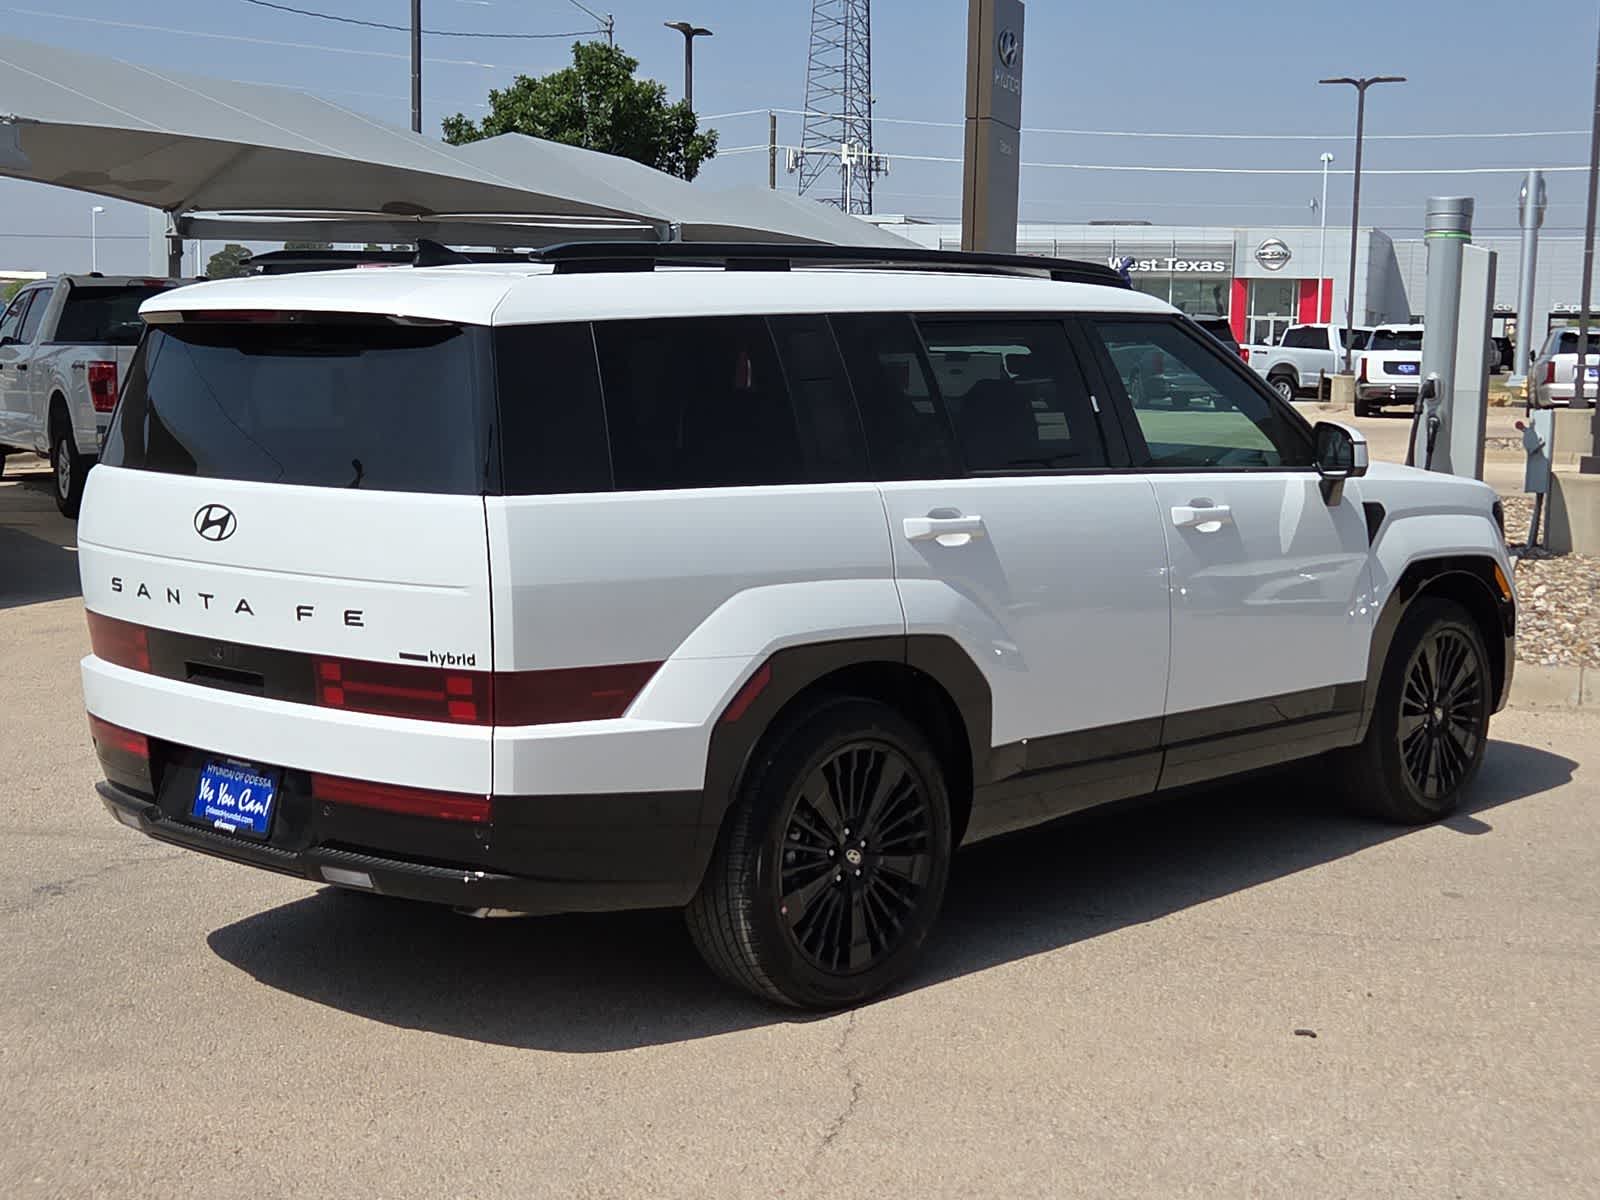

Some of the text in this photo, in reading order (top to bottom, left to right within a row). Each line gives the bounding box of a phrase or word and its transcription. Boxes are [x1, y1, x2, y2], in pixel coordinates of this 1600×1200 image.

[1164, 258, 1225, 272] Texas
[111, 577, 365, 628] SANTA FE
[430, 650, 476, 667] hybrid
[207, 765, 271, 787] HYUNDAI OF ODESSA
[199, 777, 272, 817] Yes You Can!
